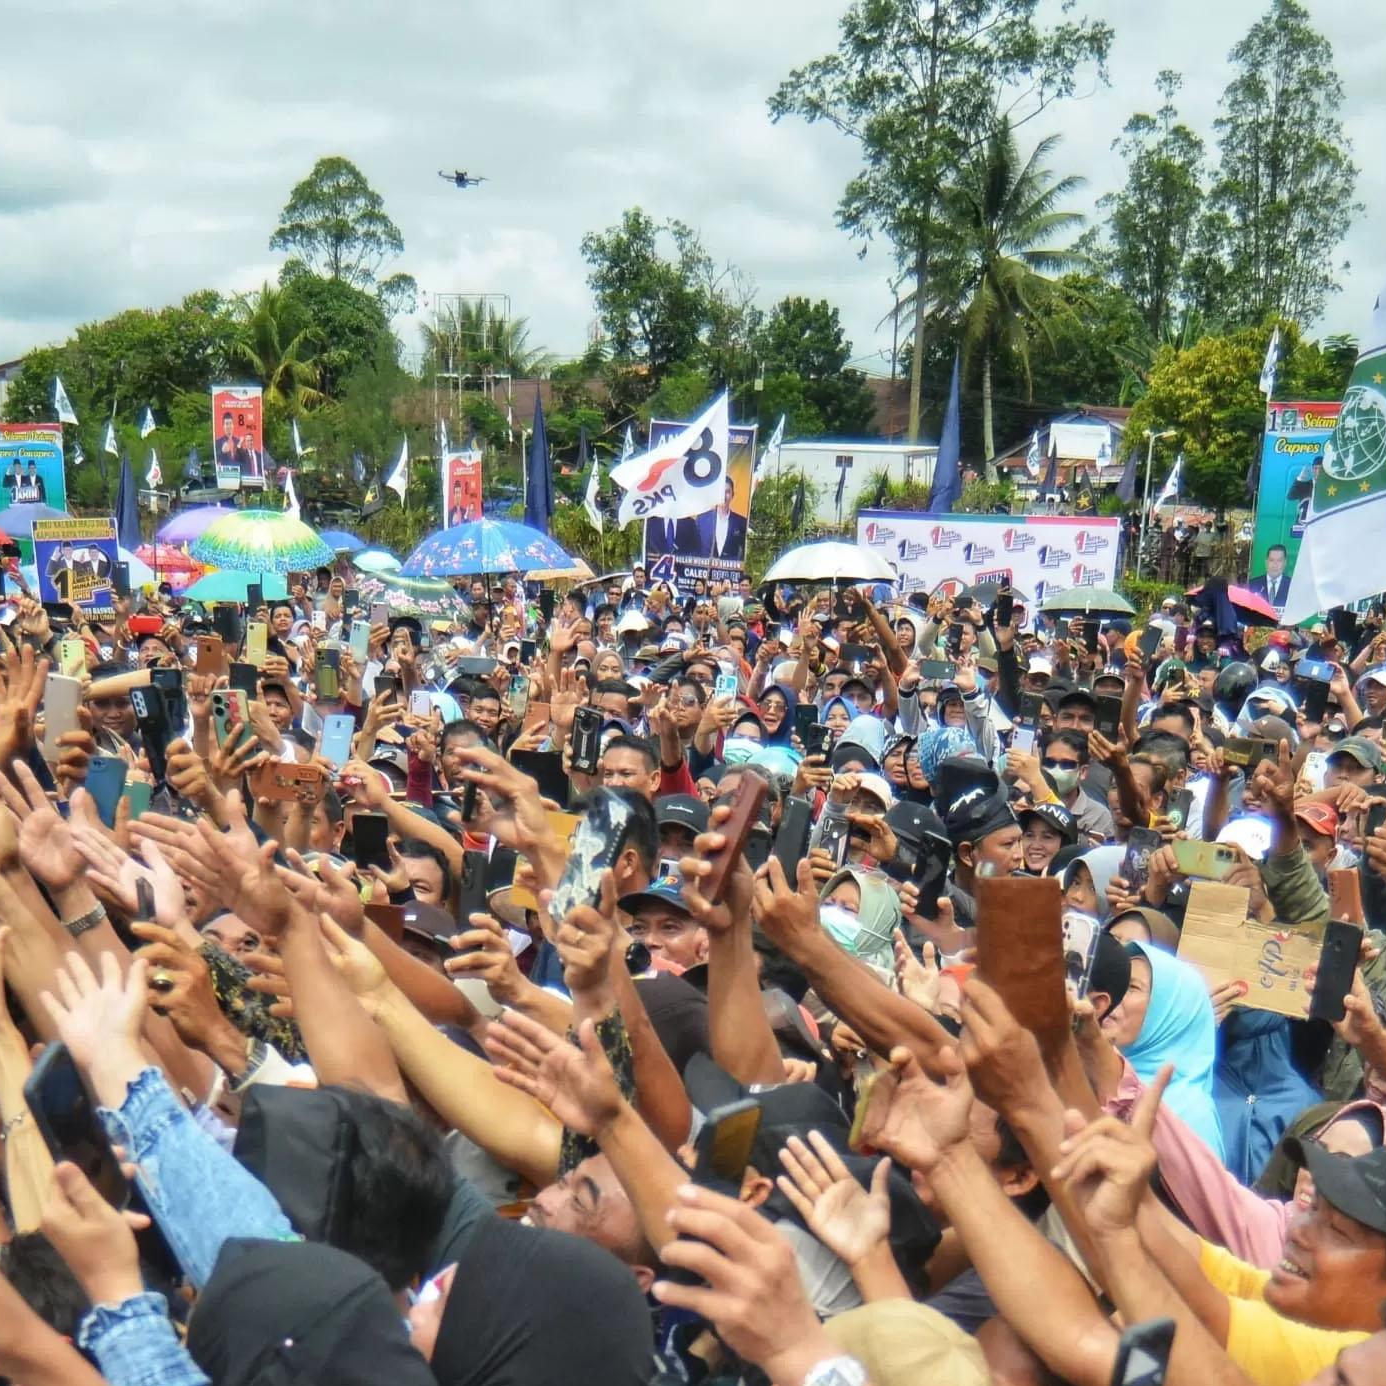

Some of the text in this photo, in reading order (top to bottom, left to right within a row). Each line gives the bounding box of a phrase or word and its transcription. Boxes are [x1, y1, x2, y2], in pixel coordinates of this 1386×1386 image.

[238, 414, 245, 427] 8
[1269, 409, 1279, 432] 1
[1302, 413, 1338, 430] Selam
[1274, 438, 1320, 457] Capres
[650, 554, 677, 583] 4
